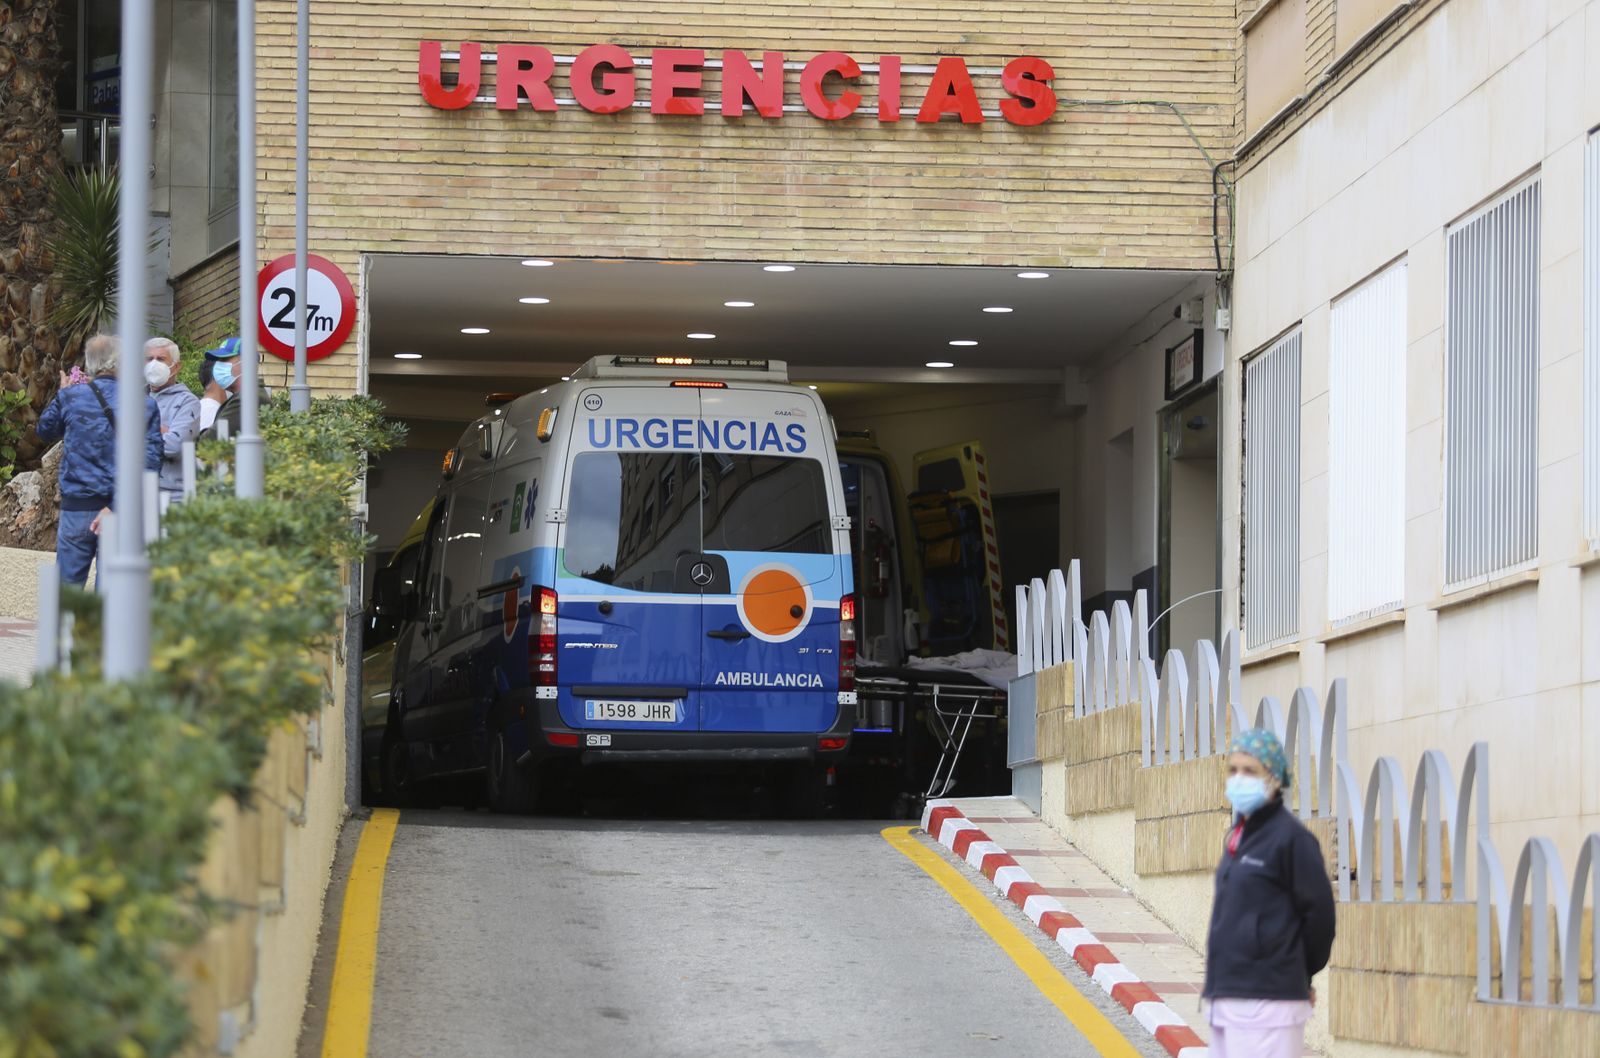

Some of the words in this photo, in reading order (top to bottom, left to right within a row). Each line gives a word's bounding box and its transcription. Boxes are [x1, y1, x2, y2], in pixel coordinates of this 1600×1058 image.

[419, 41, 1057, 127] URGENCIAS
[588, 418, 807, 455] URGENCIAS
[715, 672, 824, 688] AMBULANCIA
[599, 703, 636, 718] 1598
[643, 704, 671, 719] JHR
[588, 735, 609, 746] SP
